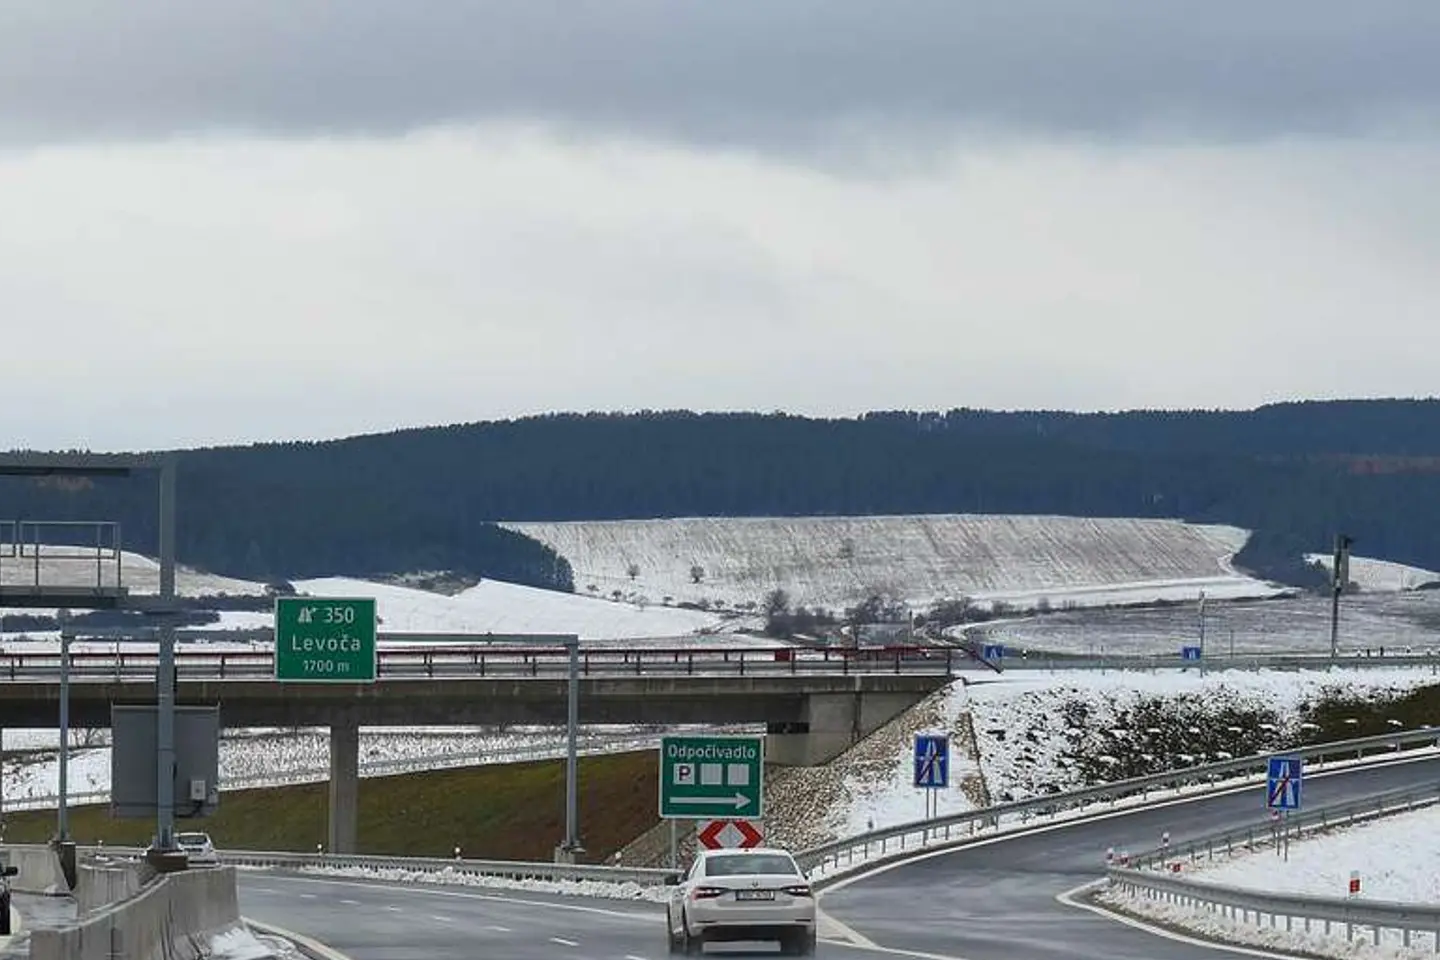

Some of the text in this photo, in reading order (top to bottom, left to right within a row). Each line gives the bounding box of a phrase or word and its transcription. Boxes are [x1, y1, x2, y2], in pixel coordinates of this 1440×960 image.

[323, 606, 354, 624] 350
[292, 633, 361, 652] Levoča
[303, 659, 351, 673] 1700 m
[678, 765, 692, 781] P
